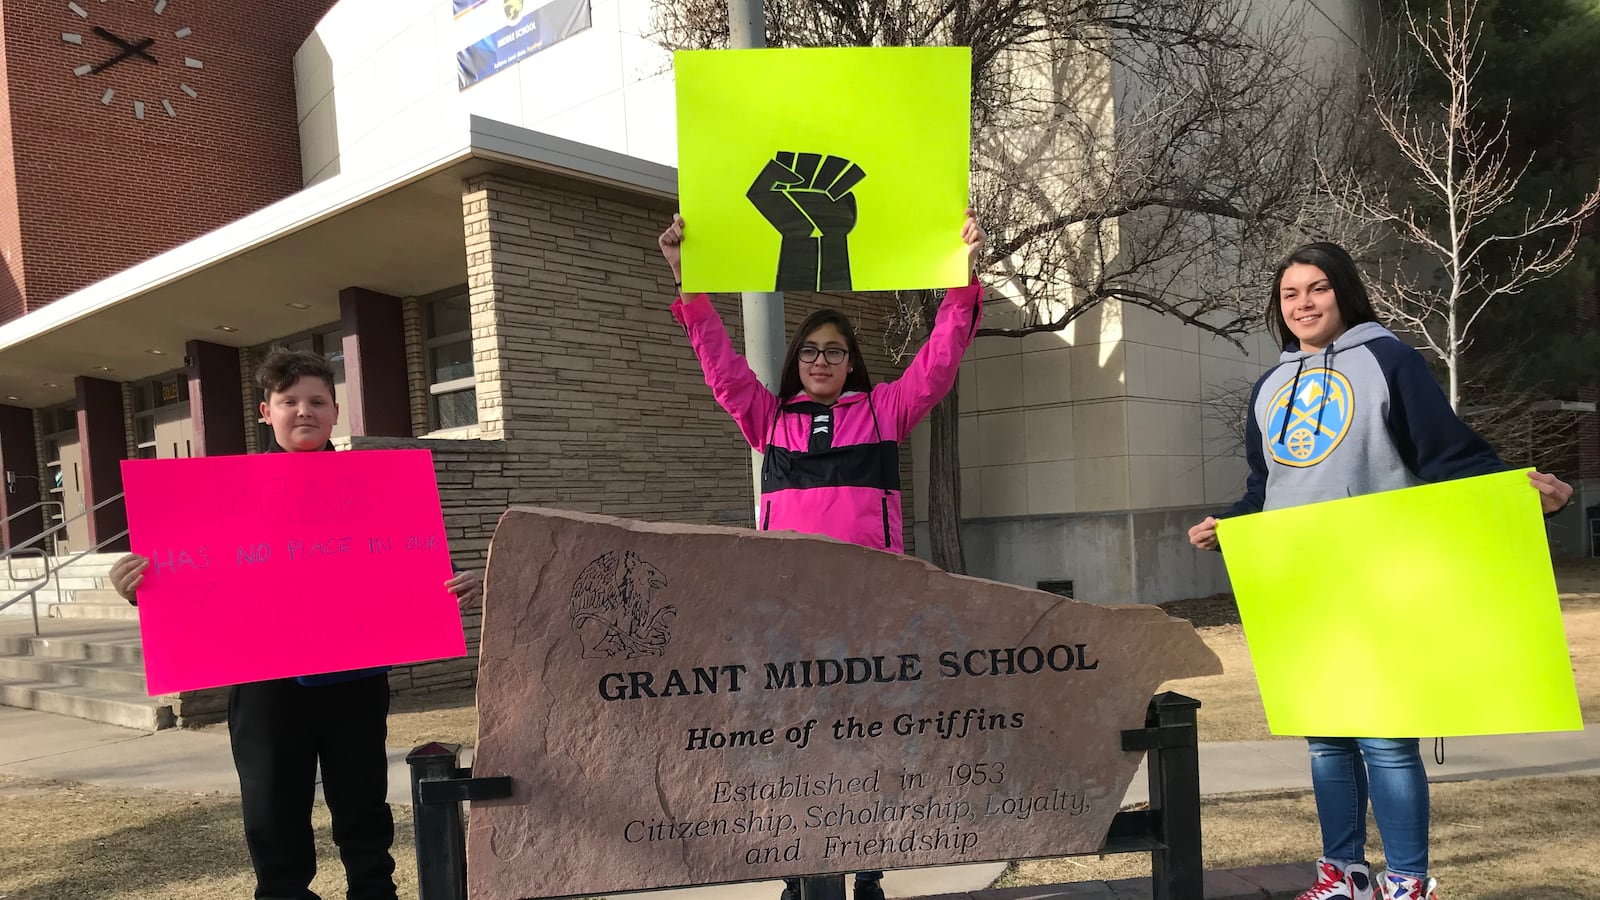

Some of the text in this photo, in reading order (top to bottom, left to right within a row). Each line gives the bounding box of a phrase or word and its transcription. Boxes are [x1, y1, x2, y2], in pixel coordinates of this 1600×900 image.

[152, 546, 211, 576] HAS
[237, 543, 271, 567] NO
[287, 537, 353, 560] PLACE
[370, 537, 392, 554] IN
[599, 644, 1099, 701] GRANT MIDDLE SCHOOL
[685, 708, 1025, 750] Home of the Griffins
[712, 762, 1005, 804] Established in 1953
[624, 788, 1091, 843] Citizenship, Scholarship, Loyalty,
[745, 826, 978, 865] and Friendship
